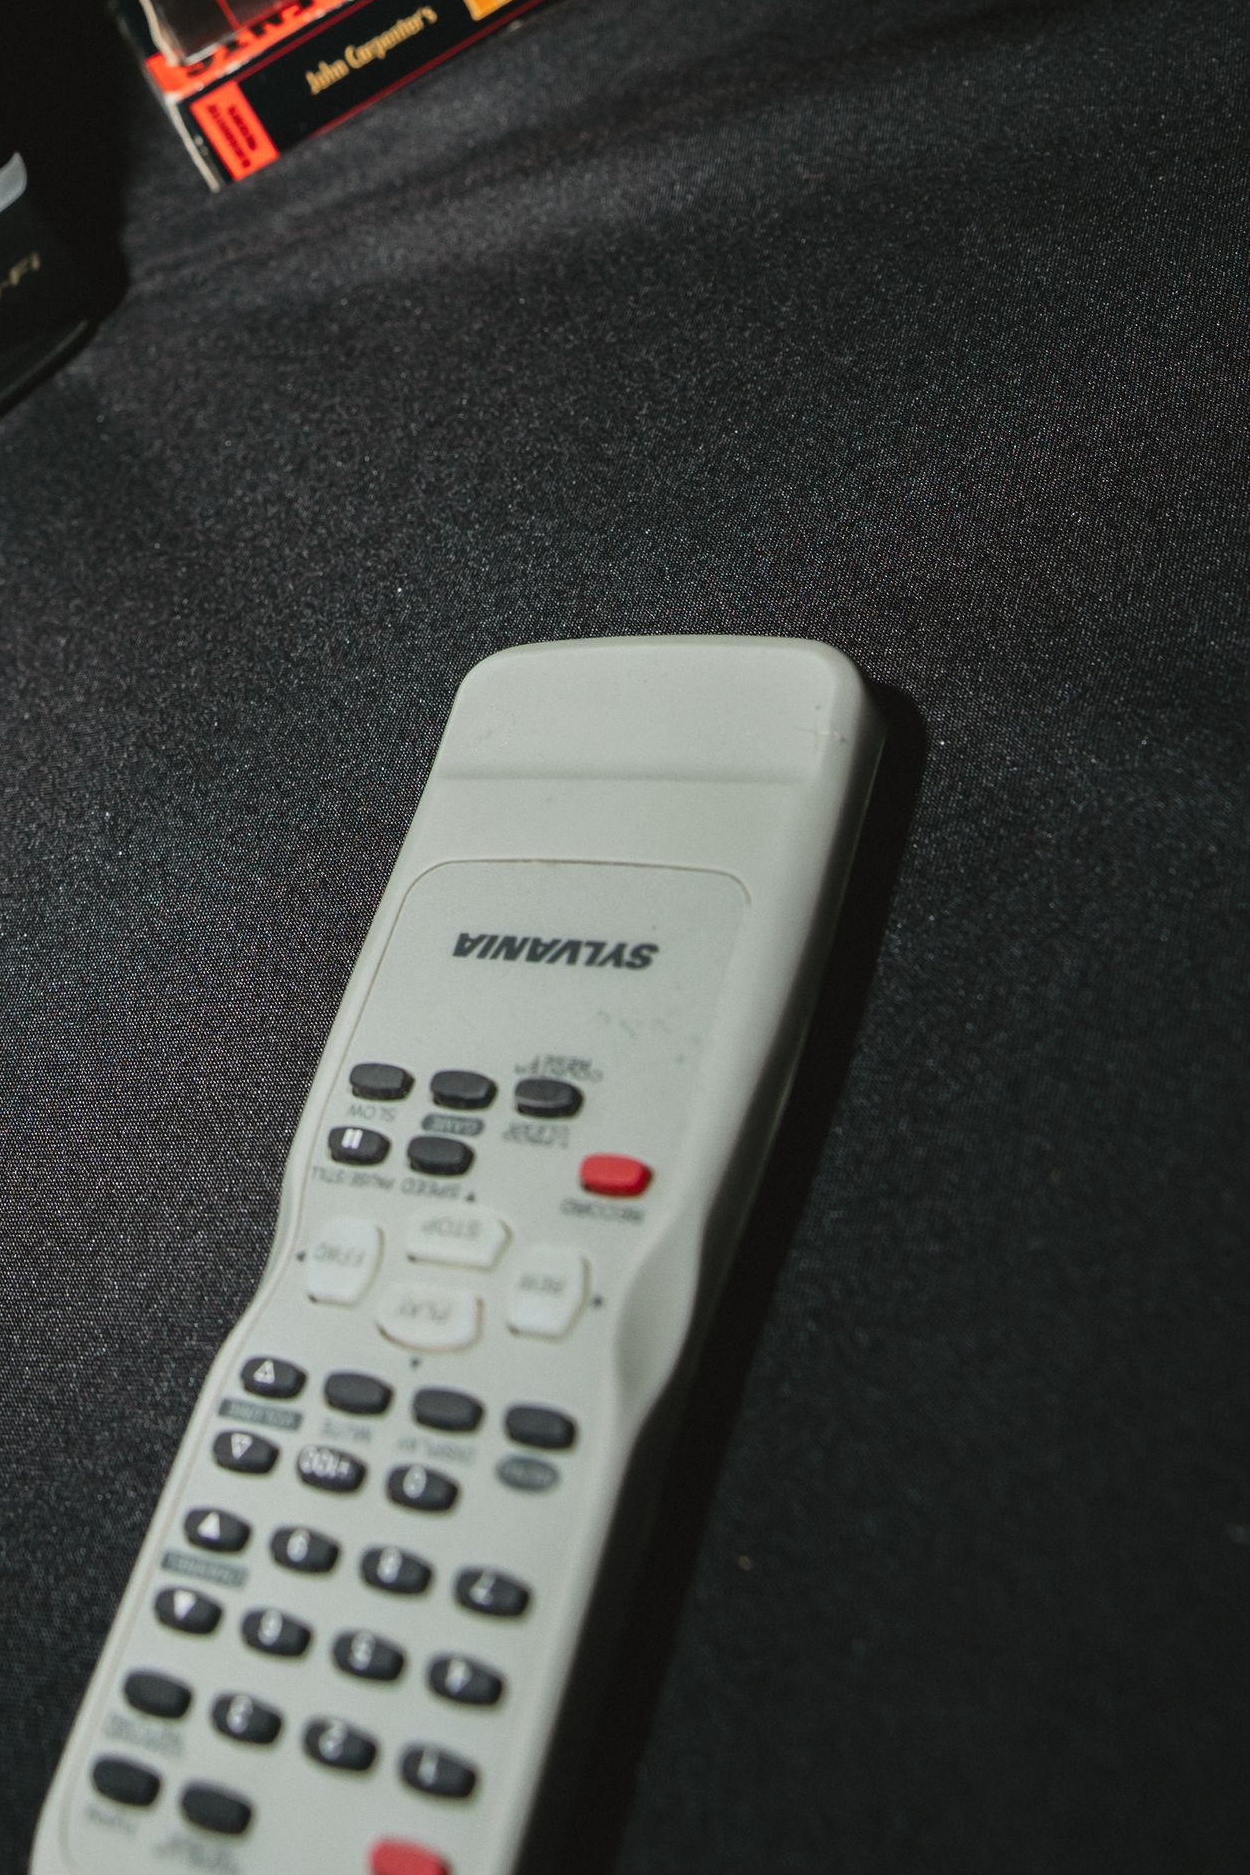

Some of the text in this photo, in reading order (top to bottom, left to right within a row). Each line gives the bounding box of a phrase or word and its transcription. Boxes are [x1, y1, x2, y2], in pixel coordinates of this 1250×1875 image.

[305, 54, 352, 96] John
[452, 932, 658, 970] SYLVANIA
[400, 1180, 461, 1202] SPEED
